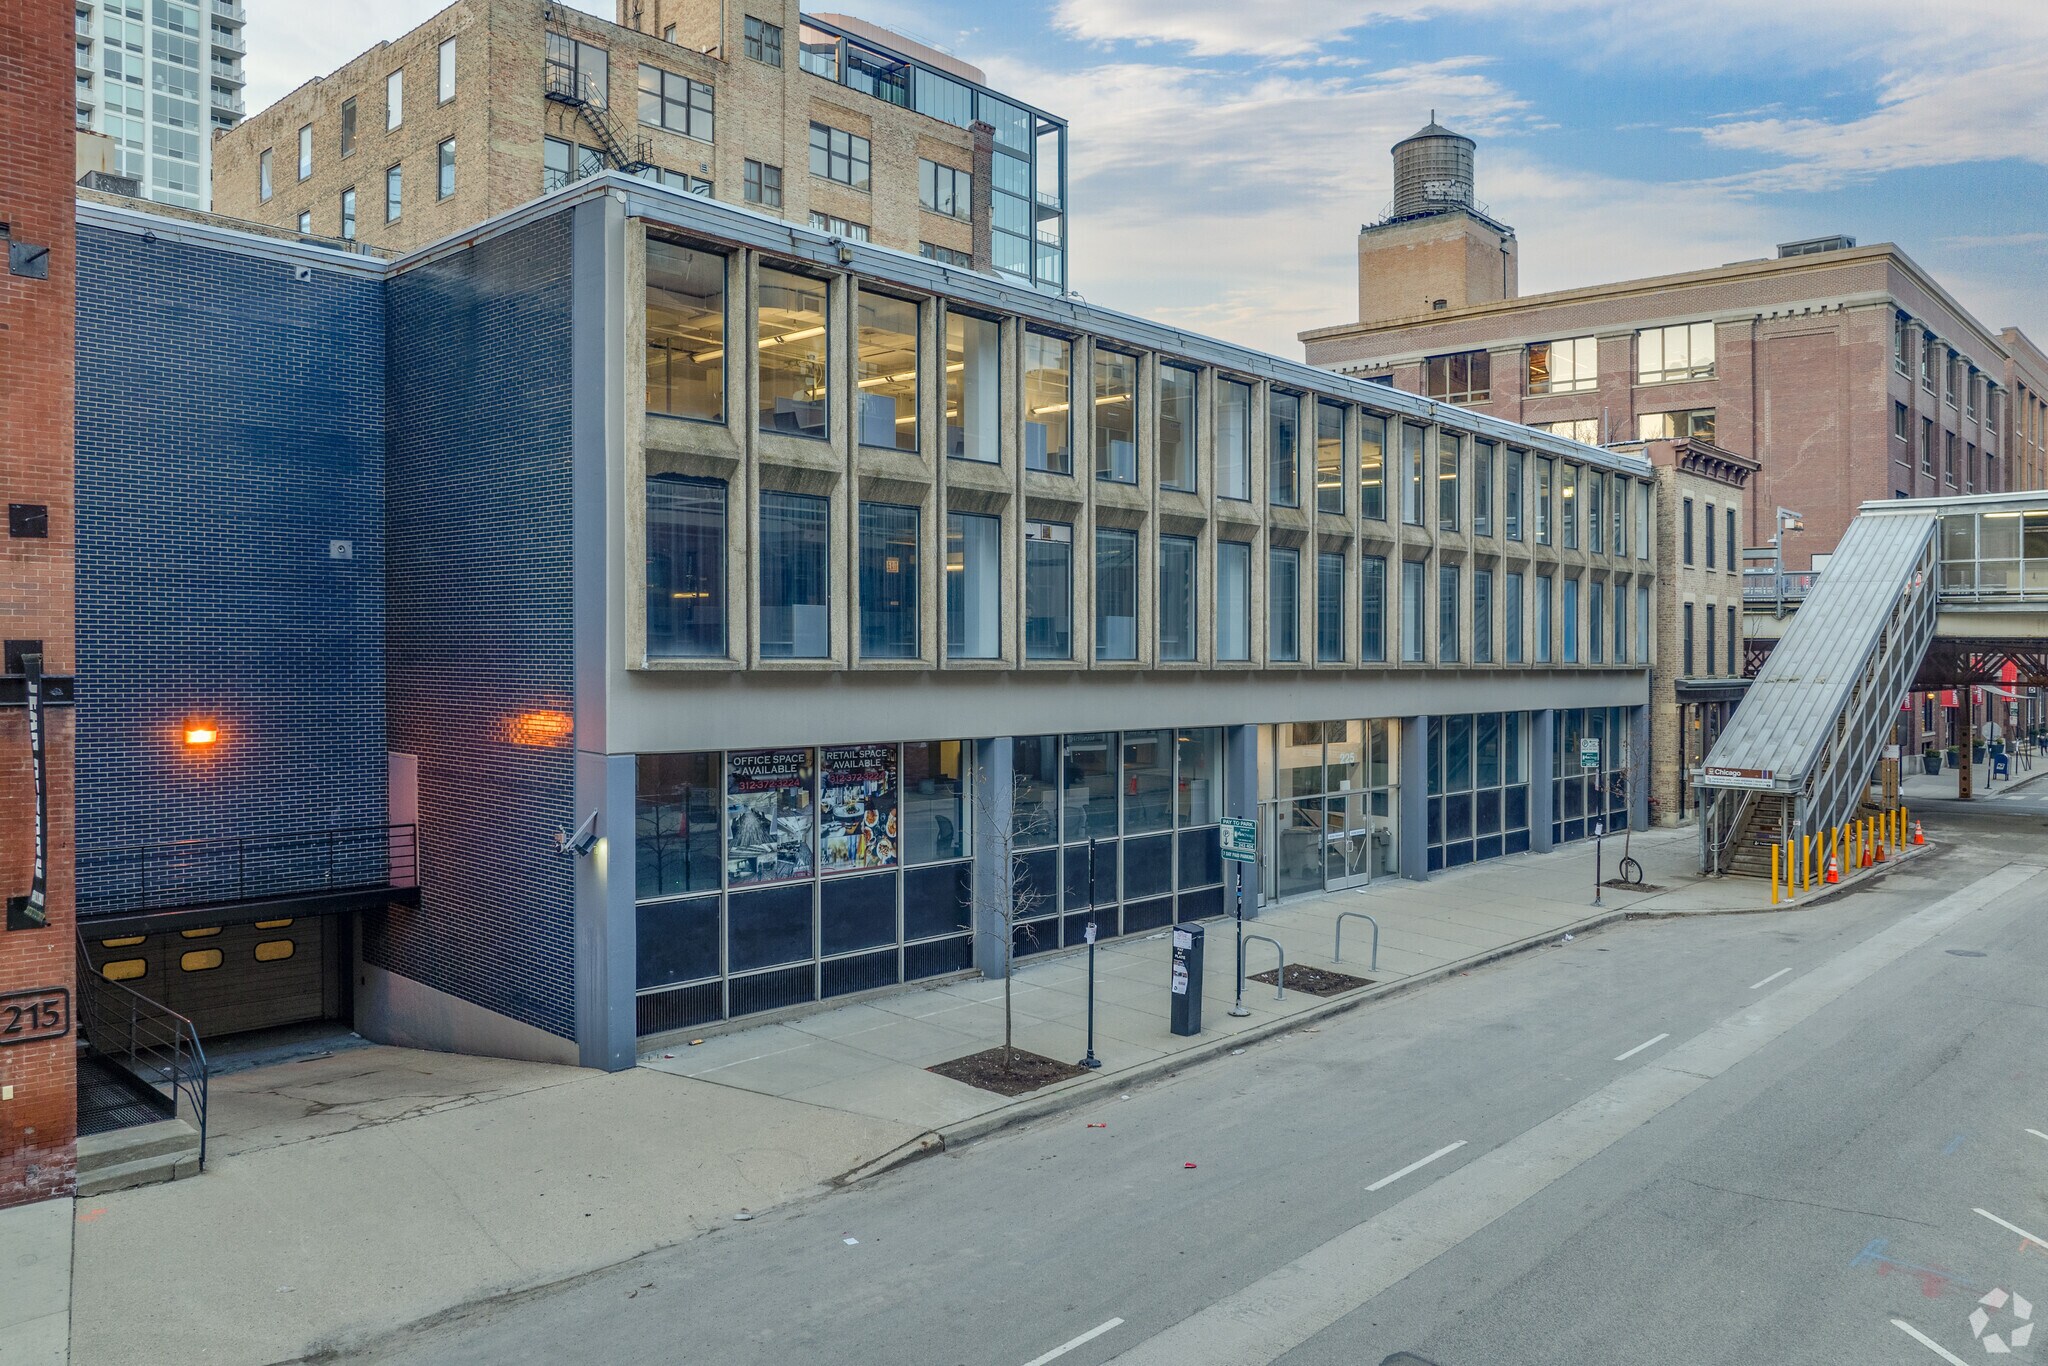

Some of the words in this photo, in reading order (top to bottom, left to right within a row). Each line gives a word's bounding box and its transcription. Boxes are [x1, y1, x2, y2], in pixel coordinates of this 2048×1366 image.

[733, 755, 771, 766] OFFICE
[773, 754, 805, 764] SPACE
[826, 751, 858, 760] RETAIL
[859, 749, 888, 758] SPACE
[1339, 752, 1355, 764] 225
[741, 764, 798, 775] AVAILABLE
[832, 759, 882, 769] AVAILABLE
[1714, 768, 1742, 777] Chicago
[3, 999, 60, 1034] 215
